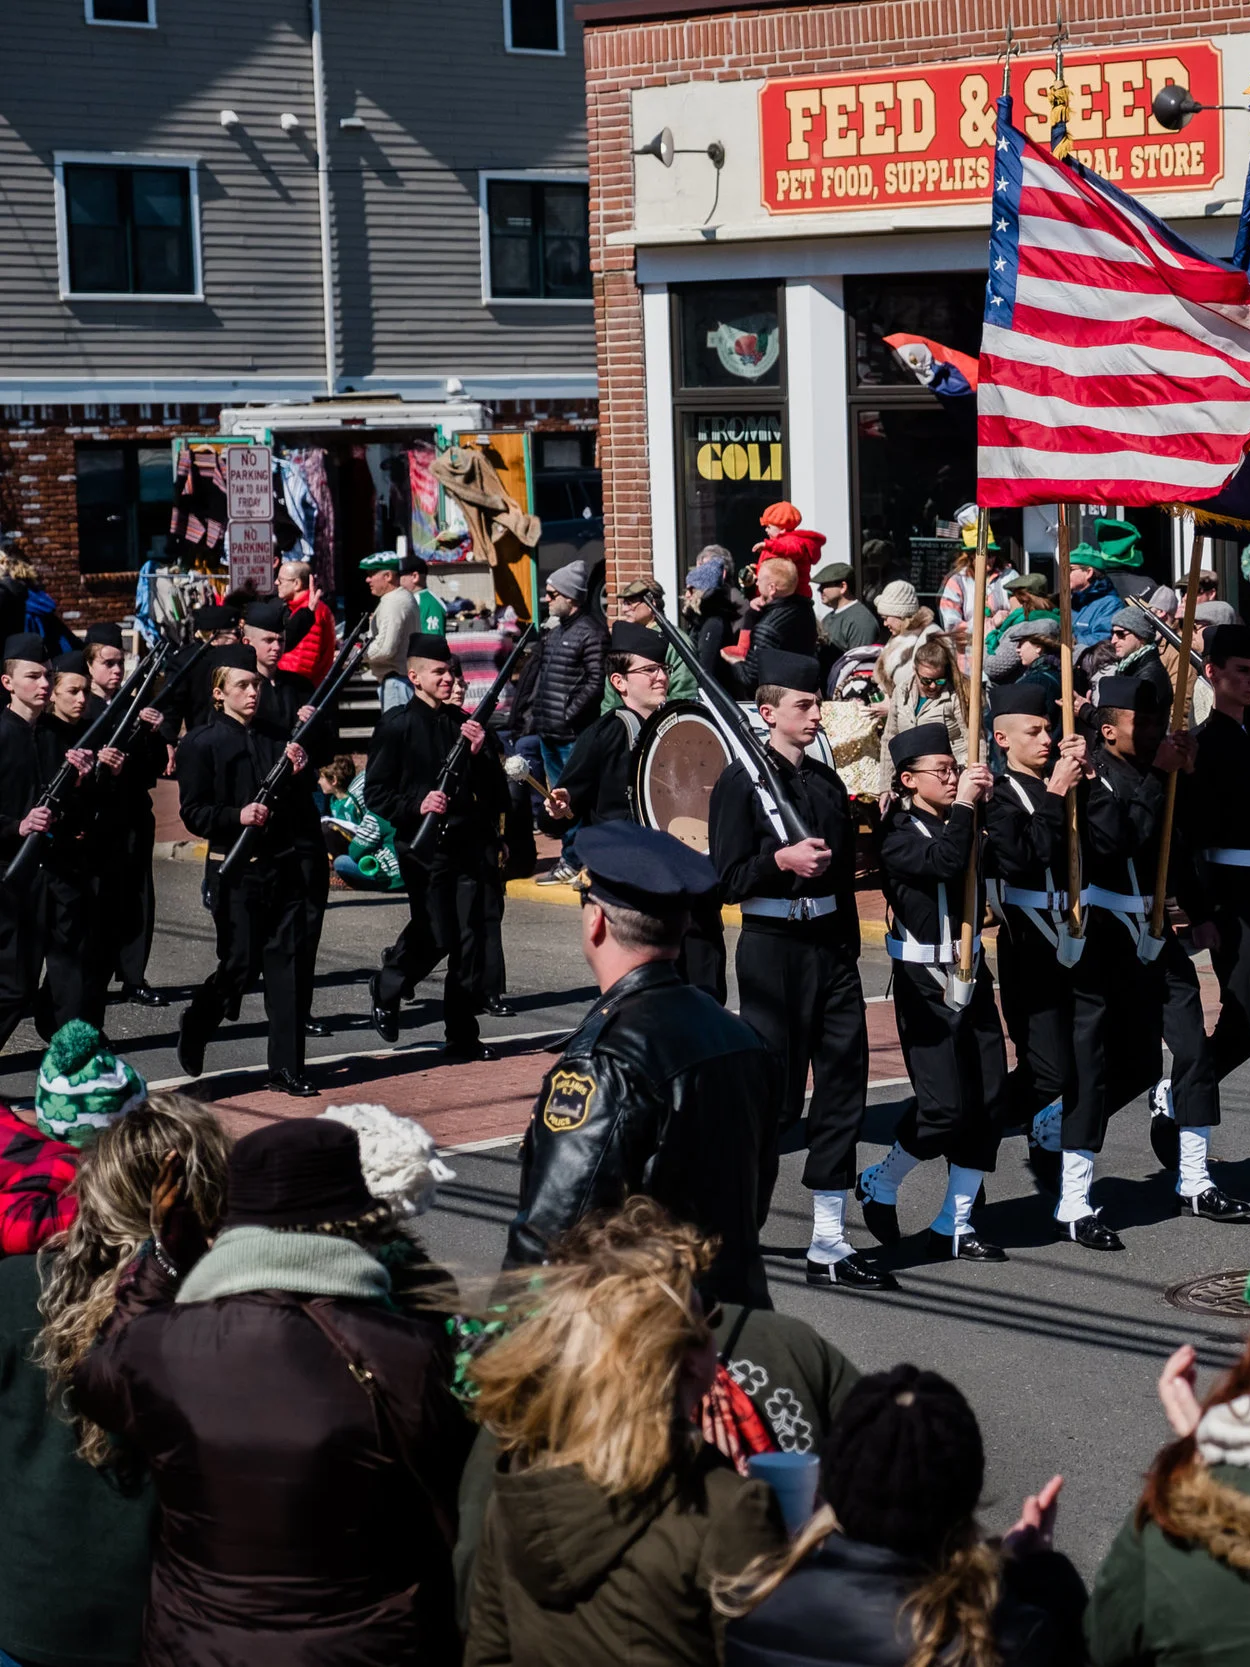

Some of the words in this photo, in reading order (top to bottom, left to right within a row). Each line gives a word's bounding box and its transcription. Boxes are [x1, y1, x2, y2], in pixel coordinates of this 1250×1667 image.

[785, 78, 937, 162] FEED
[958, 73, 997, 149] &
[1023, 55, 1192, 144] SEED
[775, 168, 815, 202] PET
[821, 163, 880, 200] FOOD,
[884, 156, 990, 195] SUPPLIES
[1130, 141, 1206, 181] STORE
[241, 453, 257, 466] NO
[230, 470, 269, 481] PARKING
[231, 483, 245, 495] 7AM
[246, 483, 254, 495] TO
[238, 497, 261, 508] FRIDAY
[243, 529, 257, 541] NO
[231, 542, 270, 554] PARKING
[232, 555, 251, 565] WHEN
[252, 554, 270, 565] ROAD
[237, 566, 245, 576] IS
